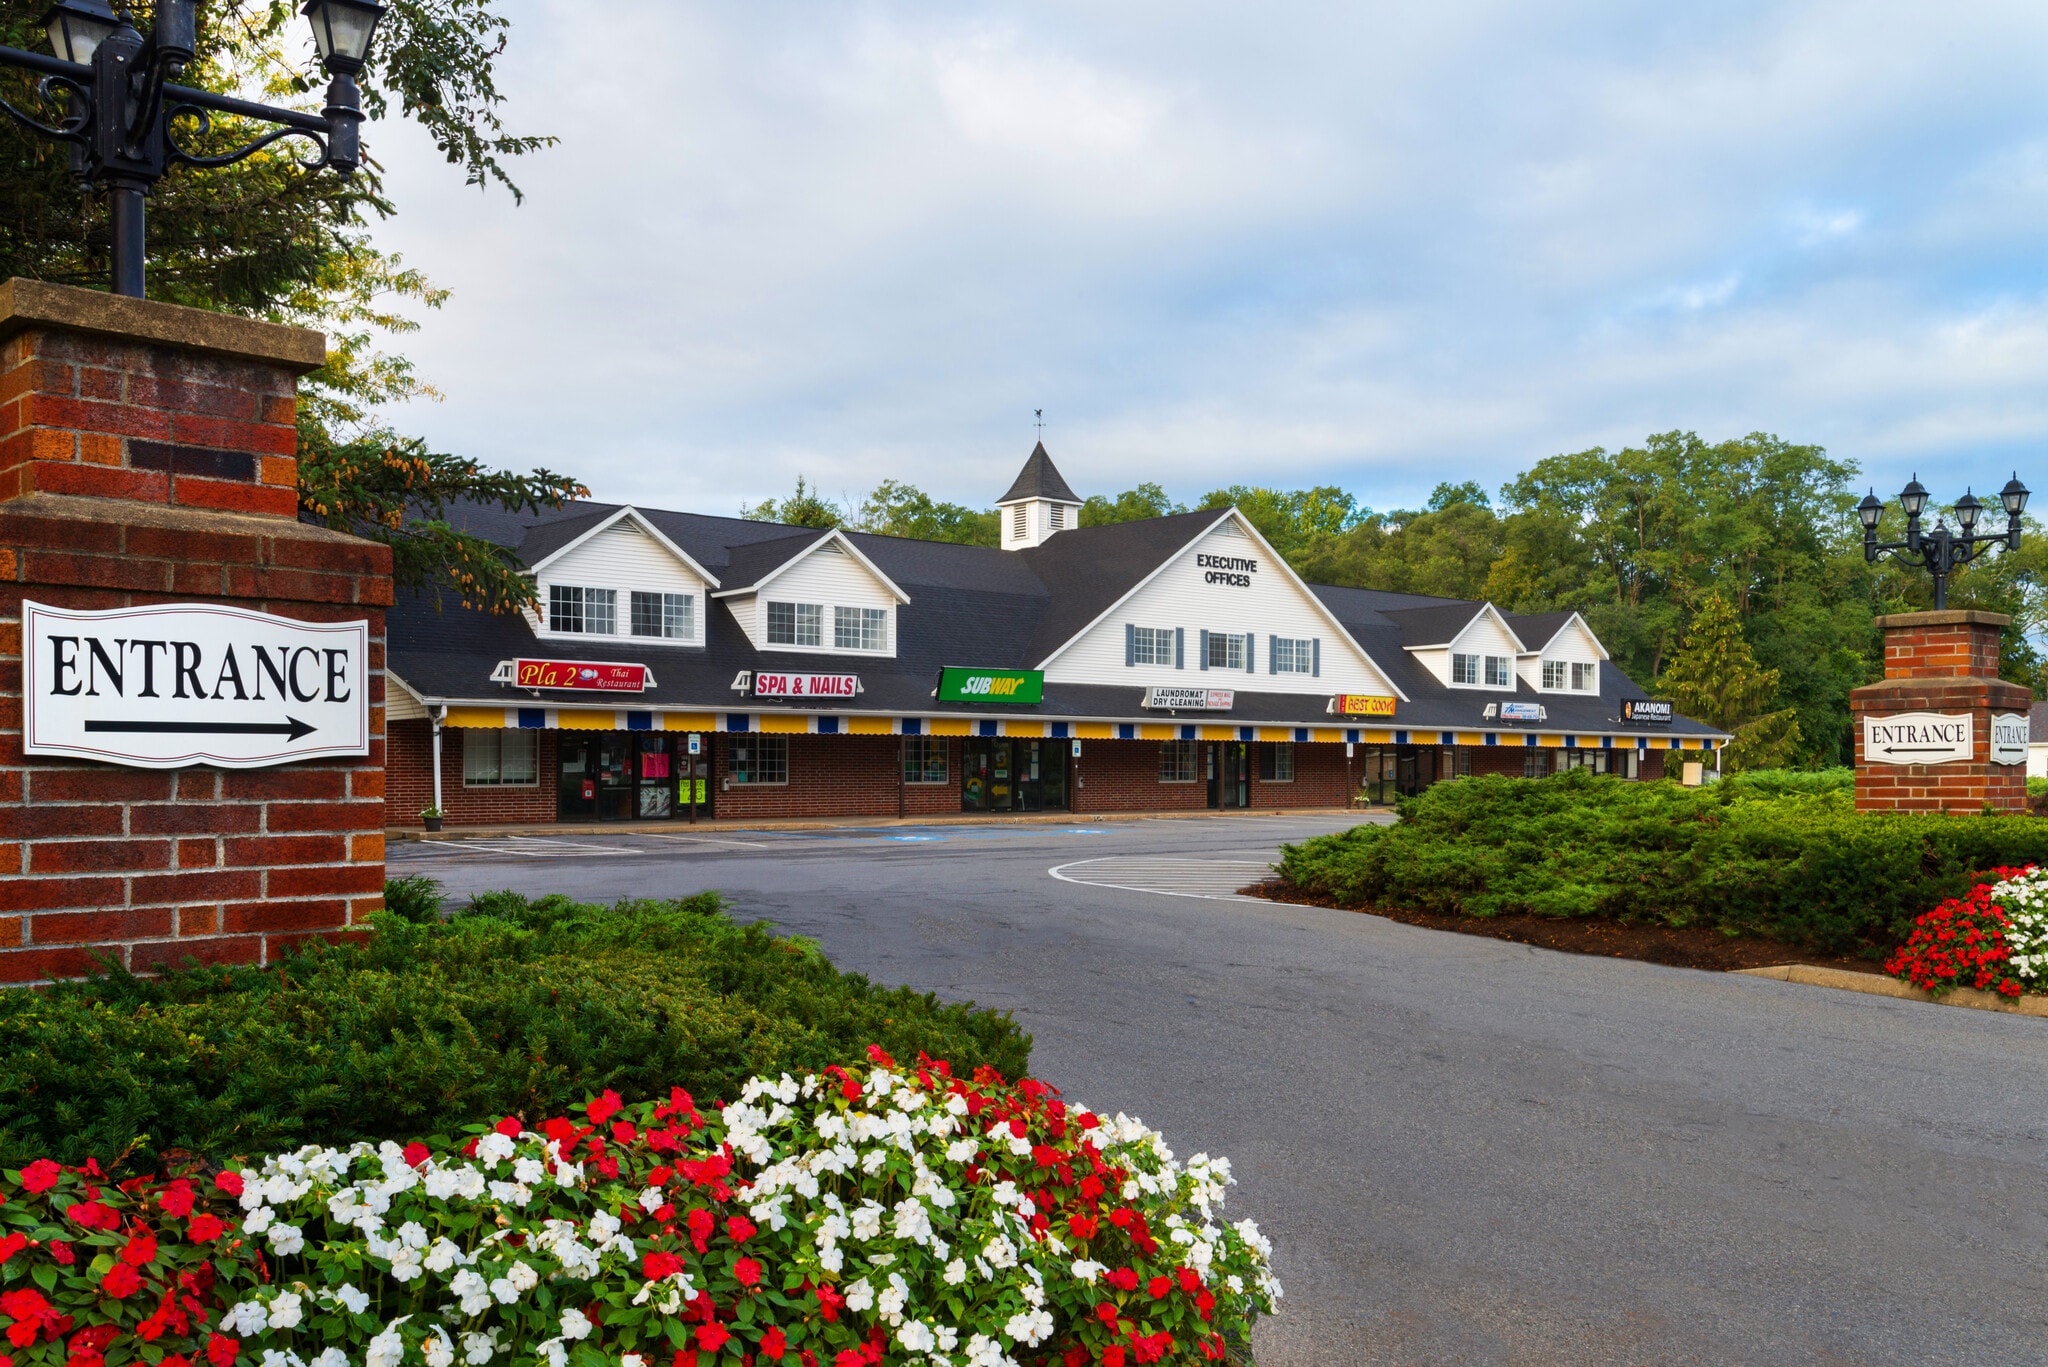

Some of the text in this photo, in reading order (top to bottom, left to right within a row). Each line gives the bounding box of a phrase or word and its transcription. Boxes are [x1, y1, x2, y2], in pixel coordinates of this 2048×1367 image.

[1197, 554, 1257, 573] EXECUTIVE
[1205, 571, 1250, 587] OFFICES
[47, 635, 350, 702] ENTRANCE
[520, 663, 577, 687] Pla 2
[610, 668, 630, 678] Thai
[596, 678, 641, 689] Restaurant
[757, 674, 854, 695] SPA & NAILS
[960, 676, 1024, 695] SUBWAY
[1156, 689, 1203, 698] LAUNDROMAT
[1153, 698, 1204, 707] DRY CLEANING
[1348, 698, 1369, 711] BEST
[1371, 698, 1393, 712] COOK
[1634, 702, 1670, 714] AKANOMI
[1872, 724, 1966, 744] ENTRANCE
[1995, 725, 2027, 744] ENTRANCE
